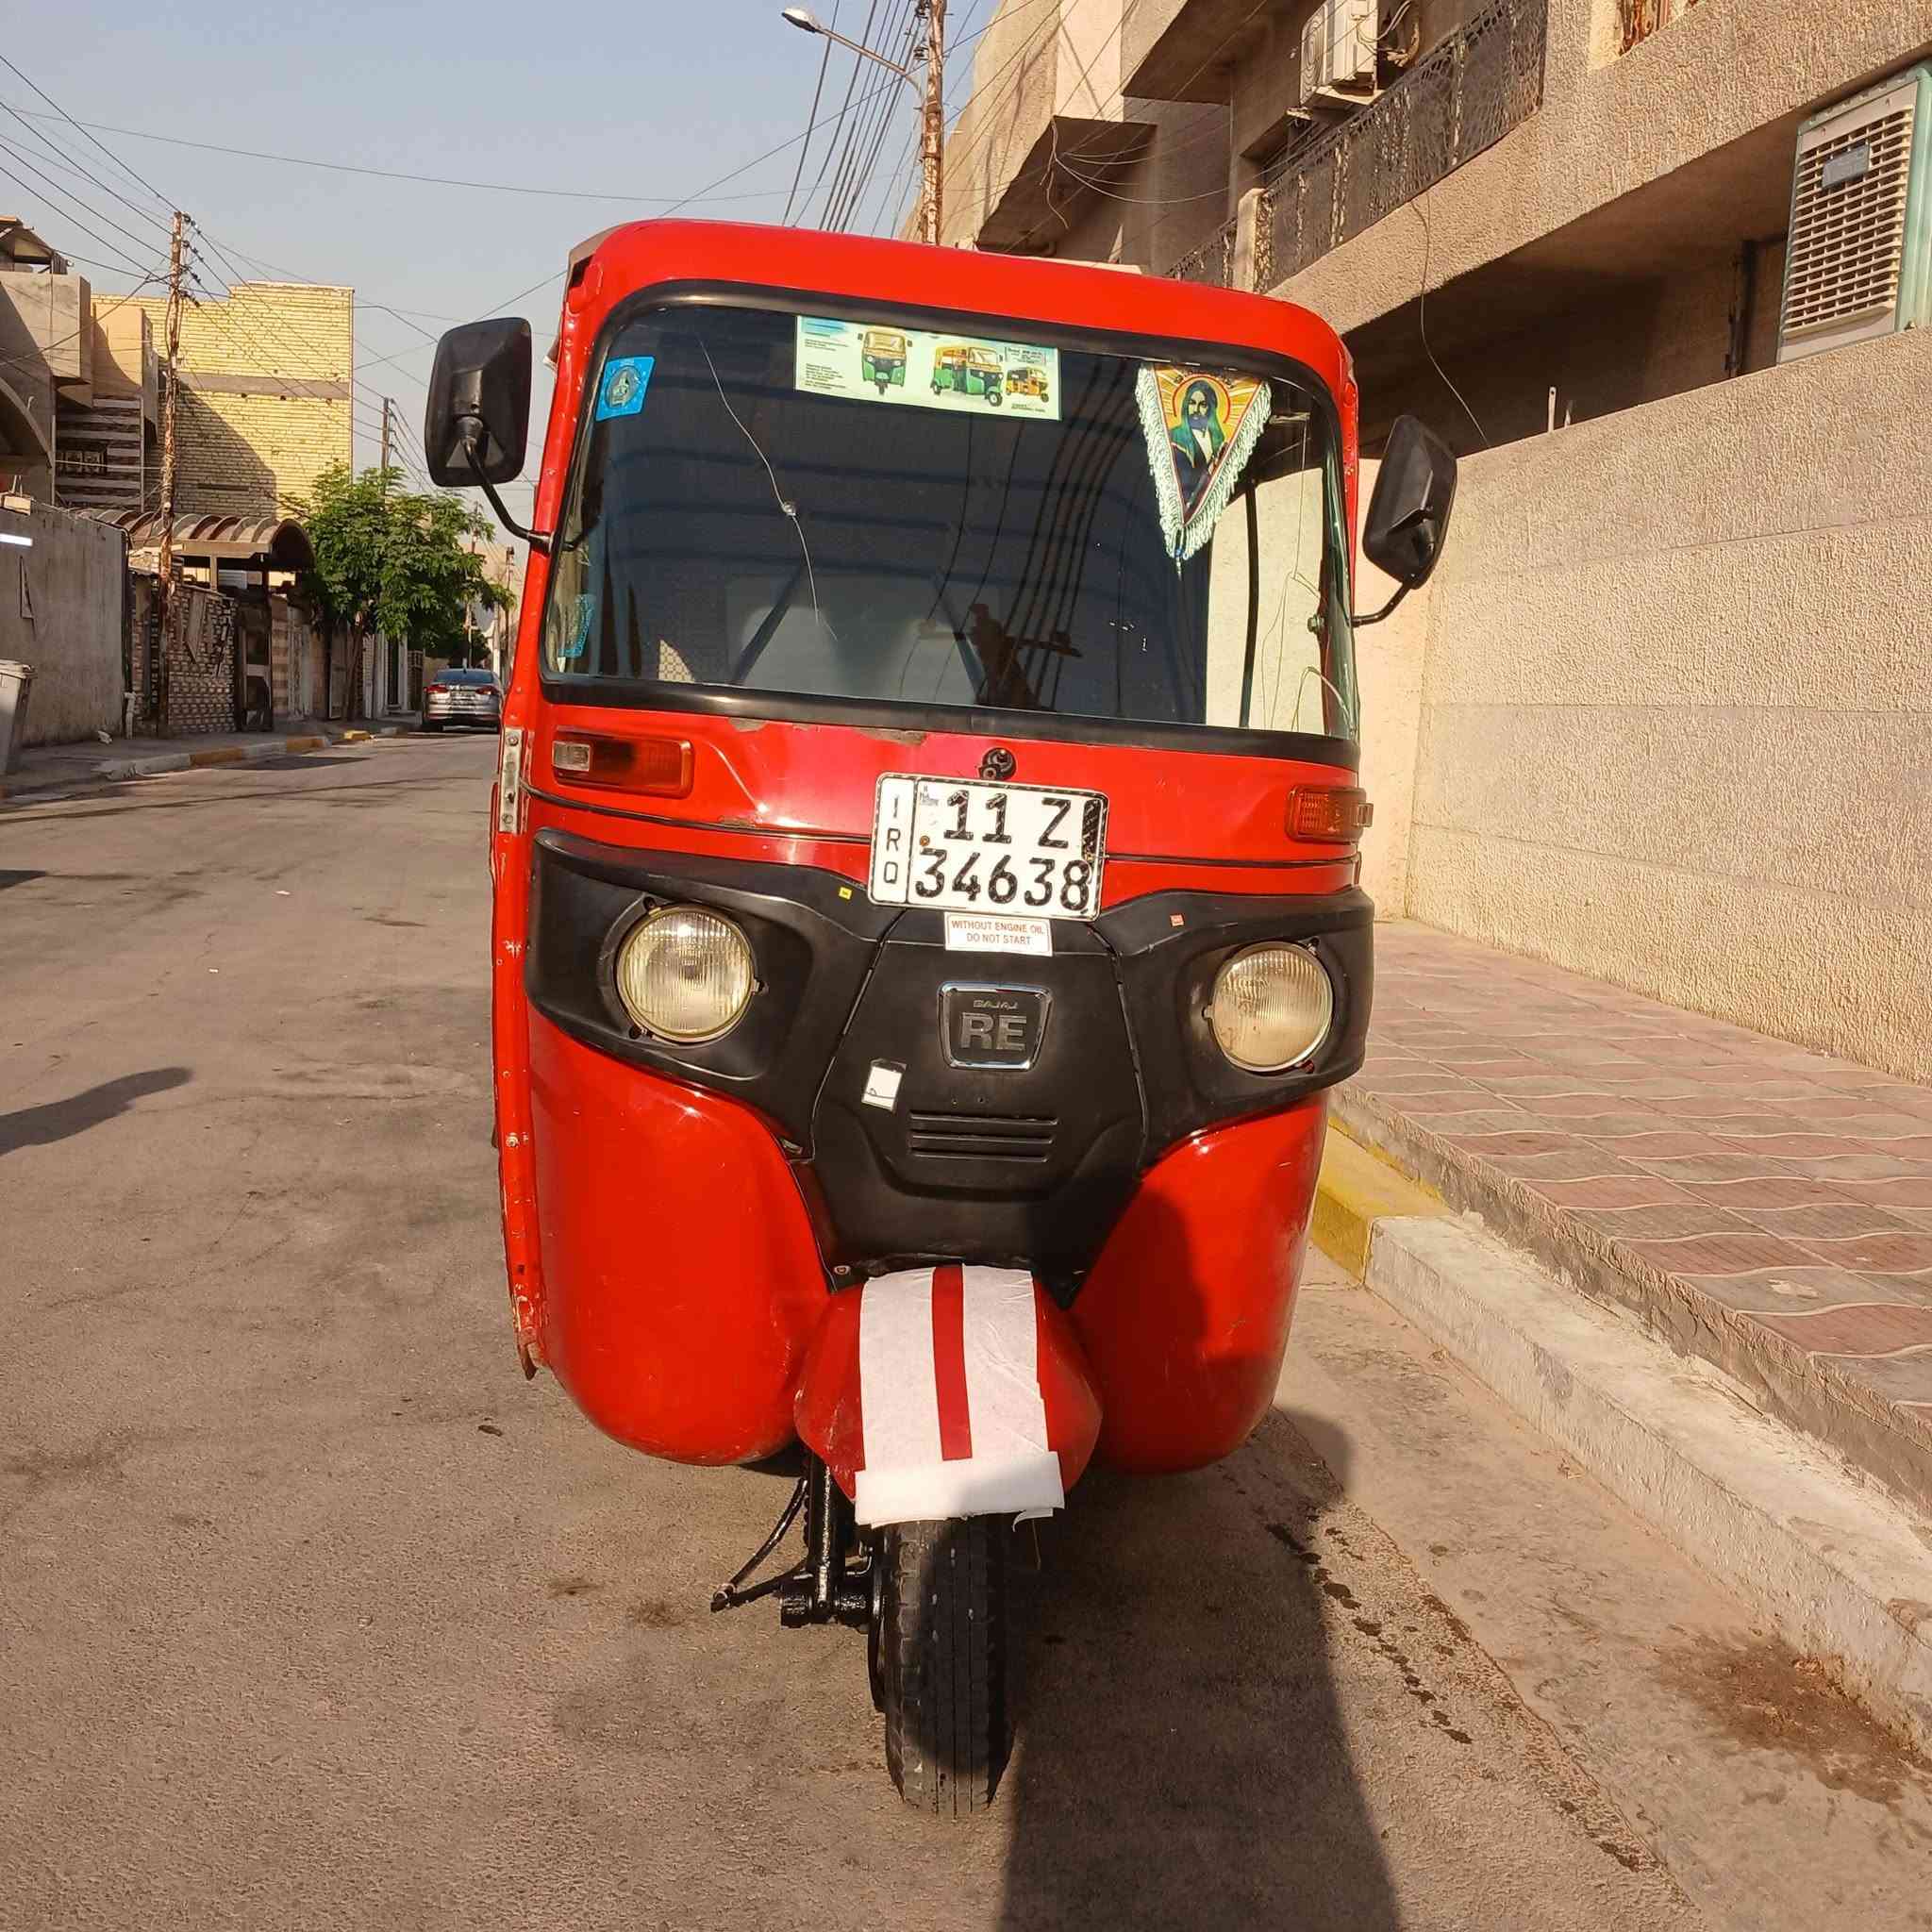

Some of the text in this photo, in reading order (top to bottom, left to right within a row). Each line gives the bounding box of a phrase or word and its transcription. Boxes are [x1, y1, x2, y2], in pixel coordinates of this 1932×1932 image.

[943, 790, 1072, 849] 11 Z
[915, 847, 1091, 911] 34638
[951, 920, 992, 930] WITHOUT
[994, 922, 1027, 933] ENGINE
[966, 932, 1031, 945] DO NOT START
[973, 998, 1019, 1011] BAJAJ
[959, 1011, 1027, 1051] RE
